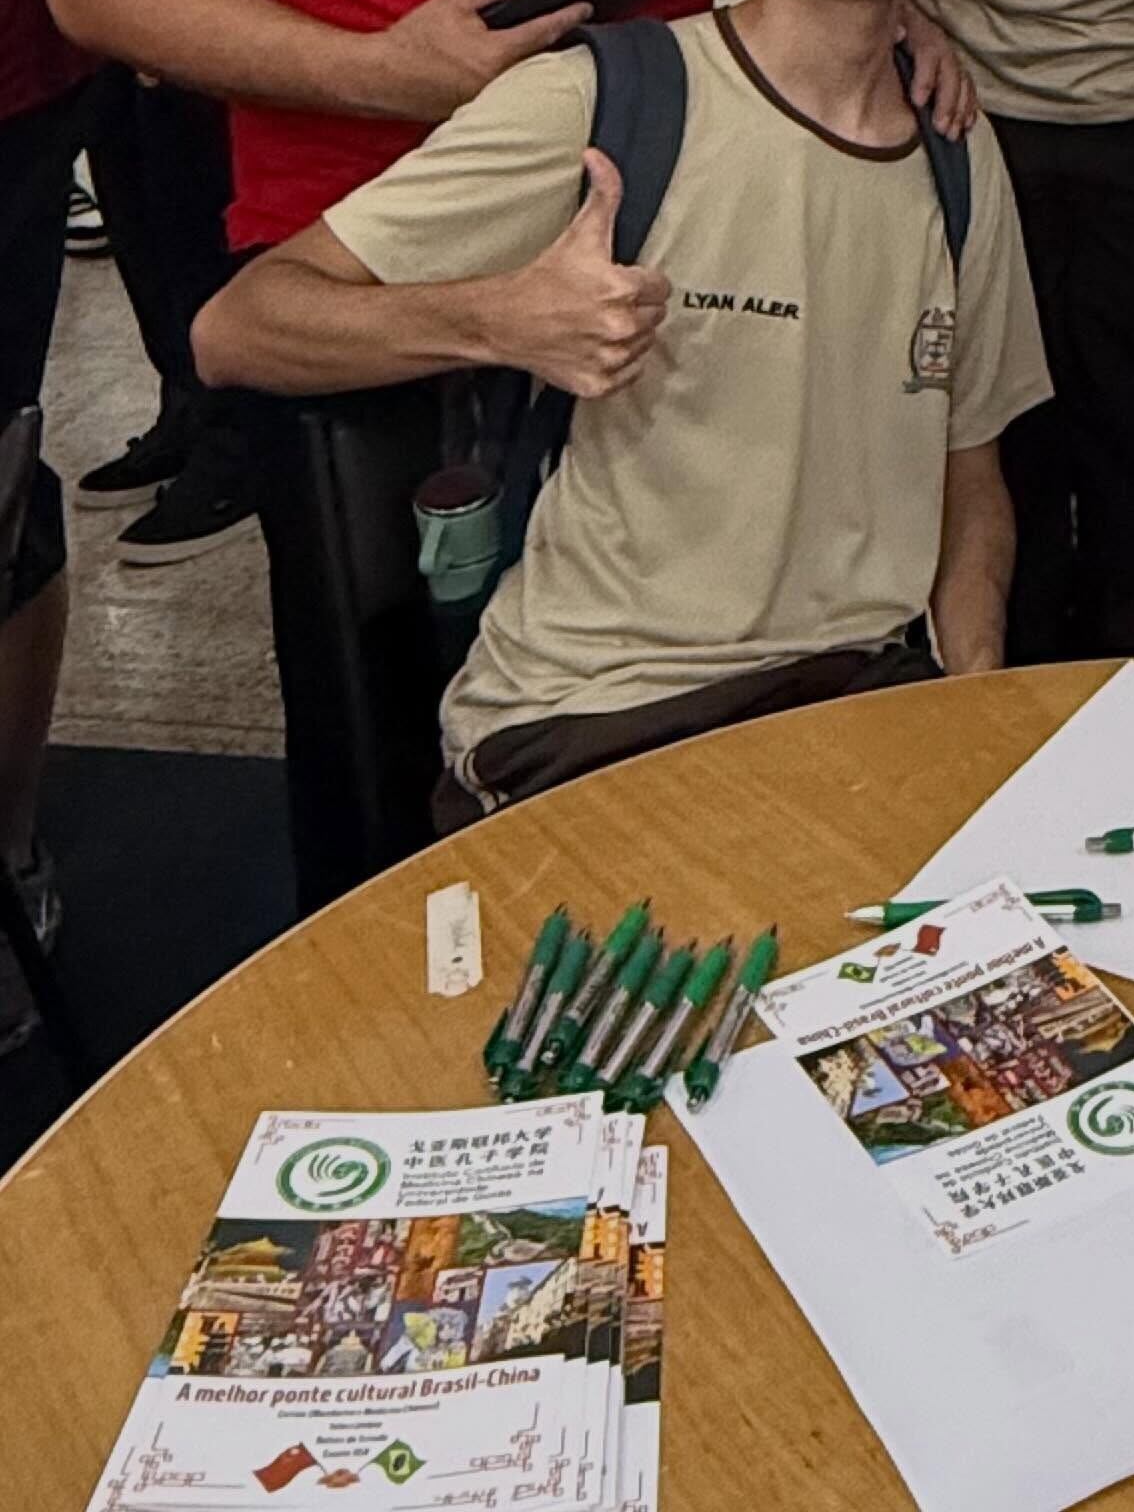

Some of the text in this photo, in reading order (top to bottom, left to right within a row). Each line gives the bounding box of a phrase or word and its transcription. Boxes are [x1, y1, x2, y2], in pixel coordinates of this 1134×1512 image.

[683, 291, 735, 311] LYAN
[175, 1365, 542, 1409] A melhor ponte cultural Brasil-China
